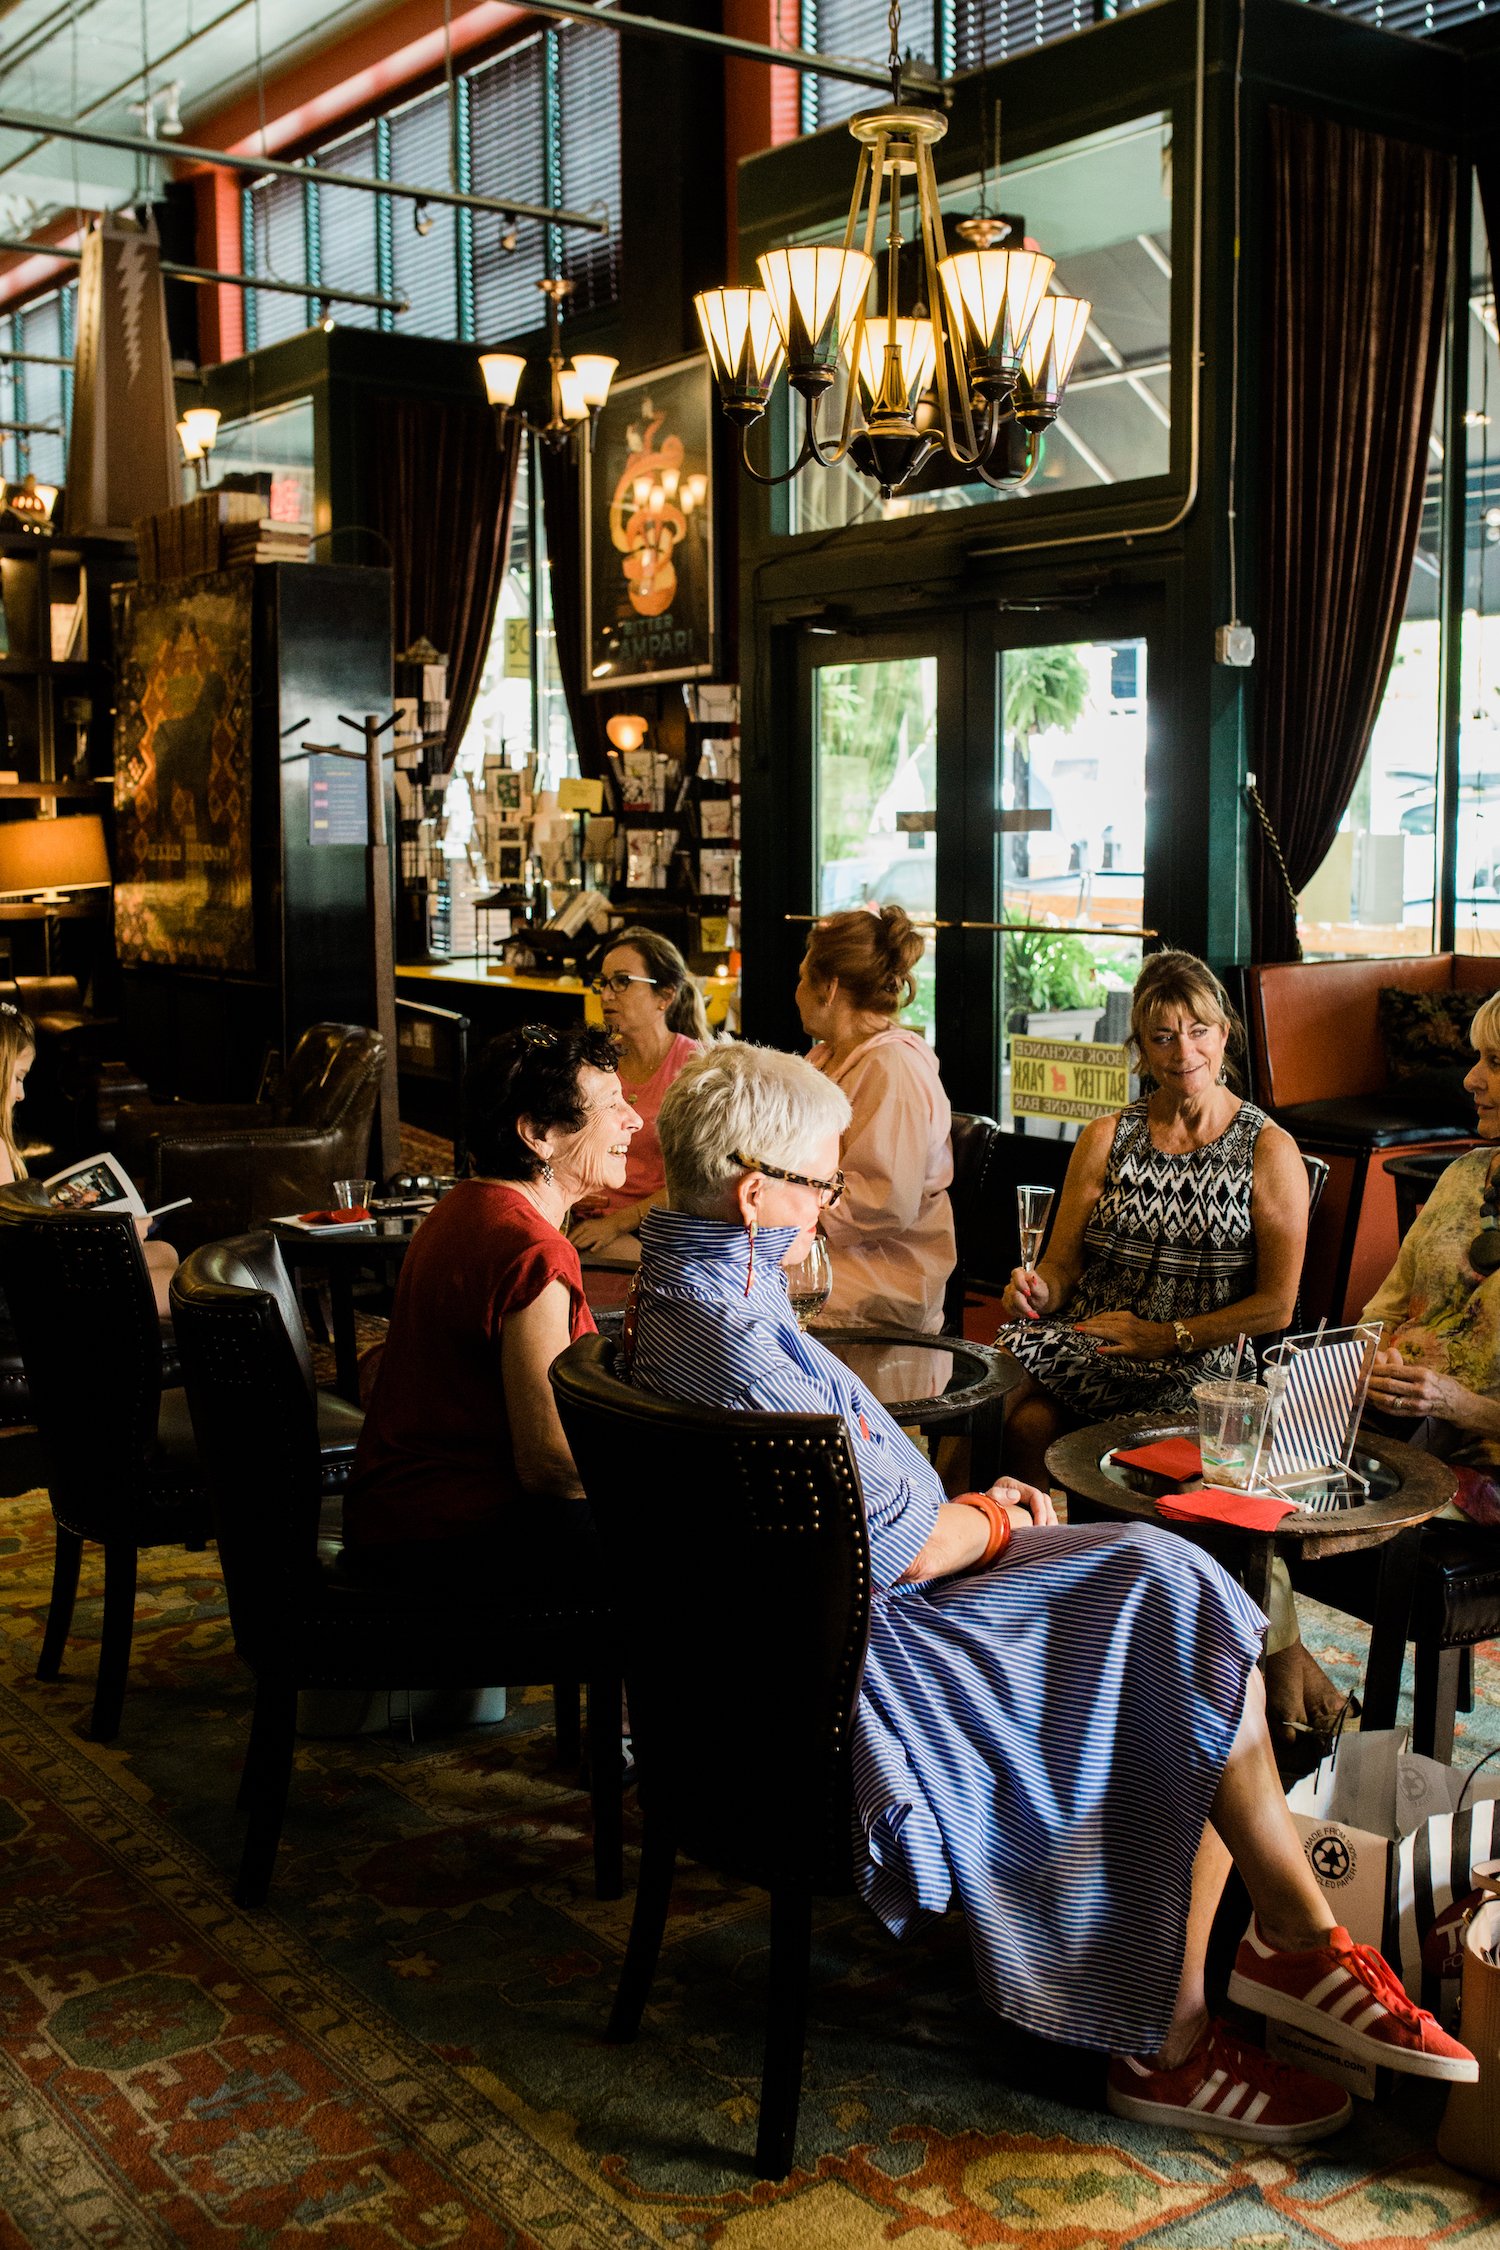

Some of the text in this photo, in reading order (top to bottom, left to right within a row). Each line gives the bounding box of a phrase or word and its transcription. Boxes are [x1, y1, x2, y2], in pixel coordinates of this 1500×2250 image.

[610, 628, 694, 659] AMPARI
[1304, 1829, 1324, 1851] MADE
[1324, 1827, 1346, 1840] FROM
[1336, 1867, 1357, 1889] PAPER
